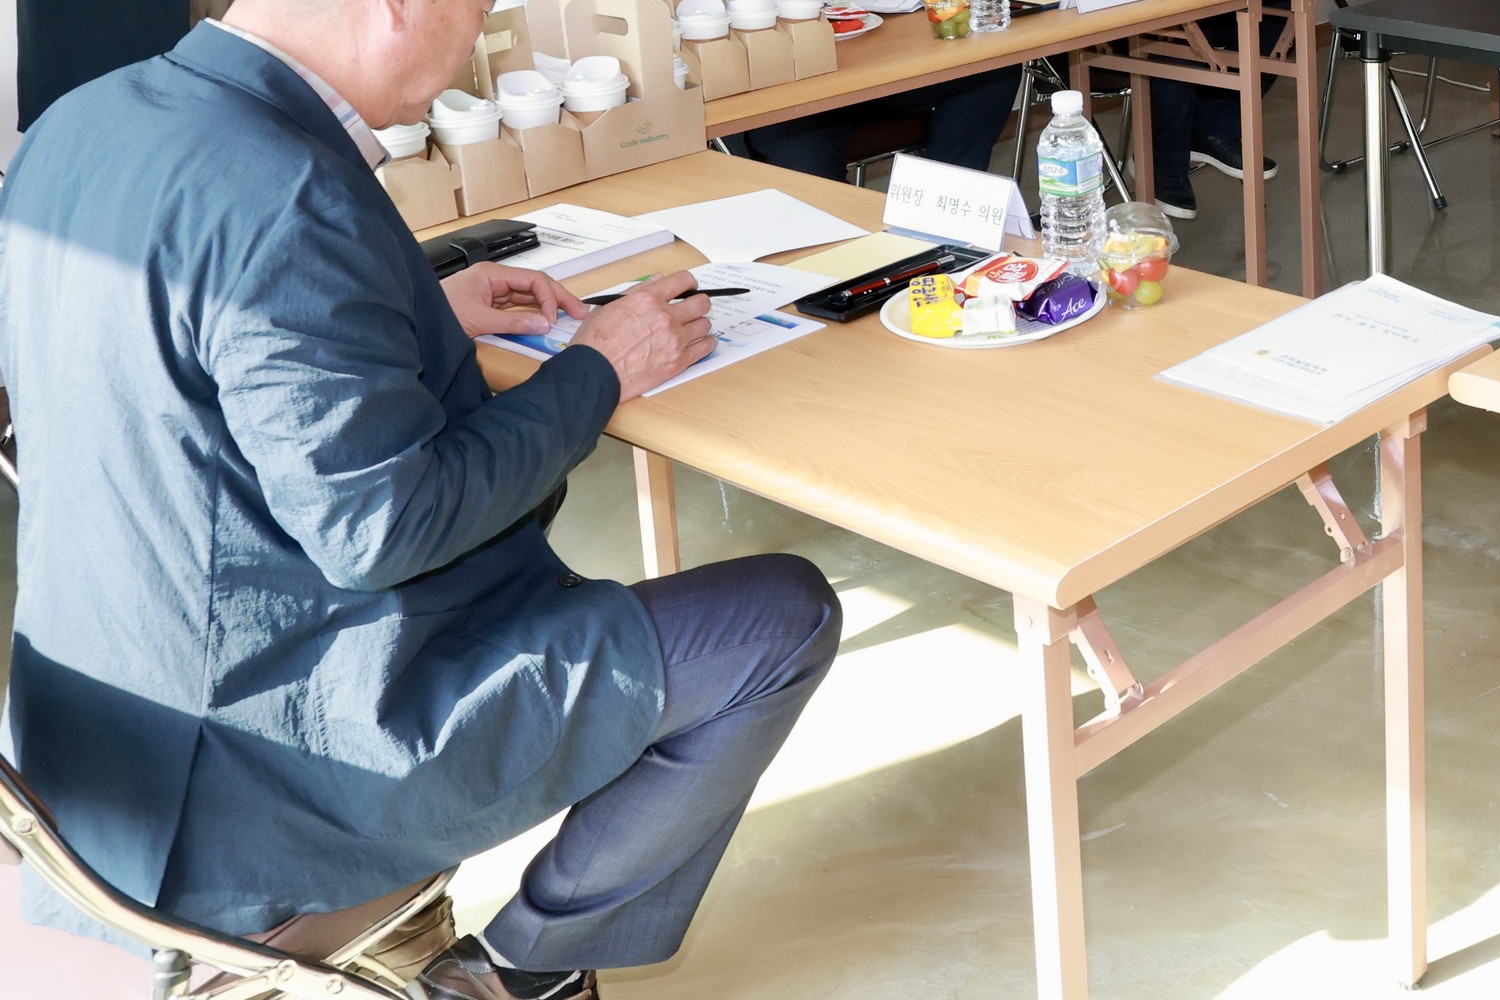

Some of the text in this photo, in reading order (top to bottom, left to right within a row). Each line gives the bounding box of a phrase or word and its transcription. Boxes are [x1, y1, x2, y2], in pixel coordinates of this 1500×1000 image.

[890, 183, 1004, 227] 위원장 최명수 의원
[1060, 296, 1087, 323] Ace
